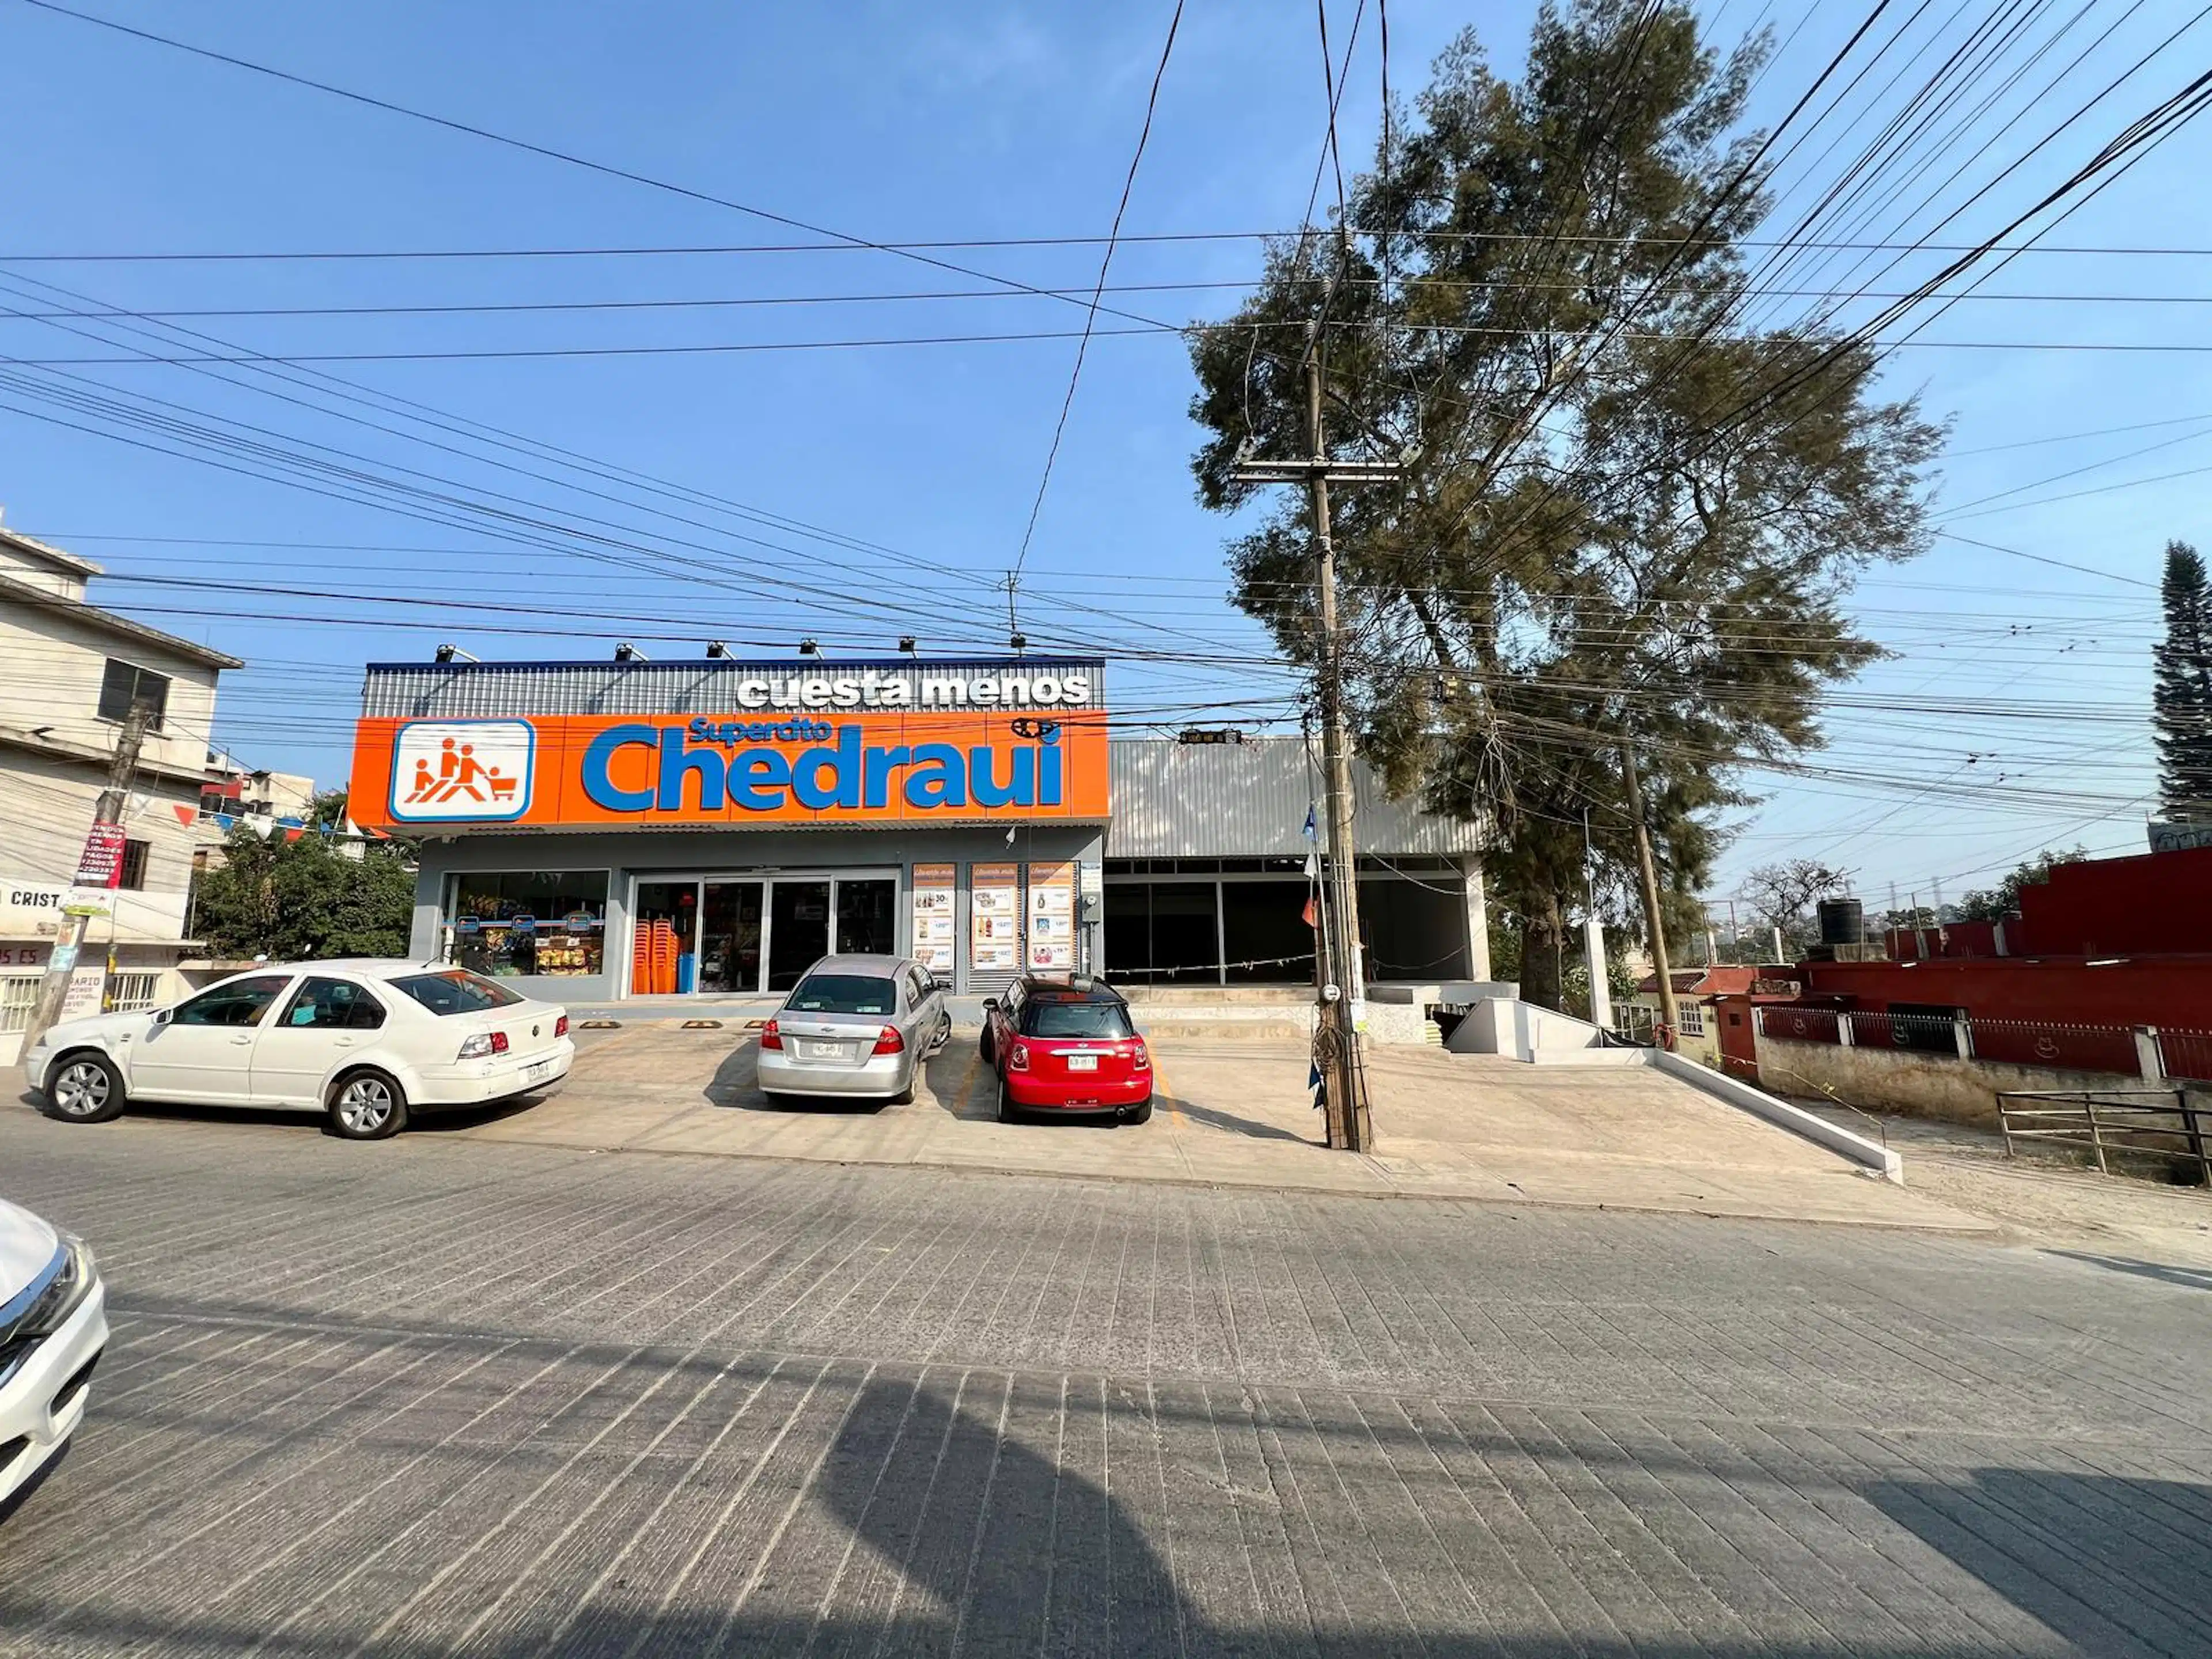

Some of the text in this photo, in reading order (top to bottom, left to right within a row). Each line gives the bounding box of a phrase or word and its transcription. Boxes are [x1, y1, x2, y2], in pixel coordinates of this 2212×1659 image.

[738, 670, 1090, 708] cuesta menos
[689, 716, 833, 748] Supercito
[581, 719, 1062, 812] Chedraui
